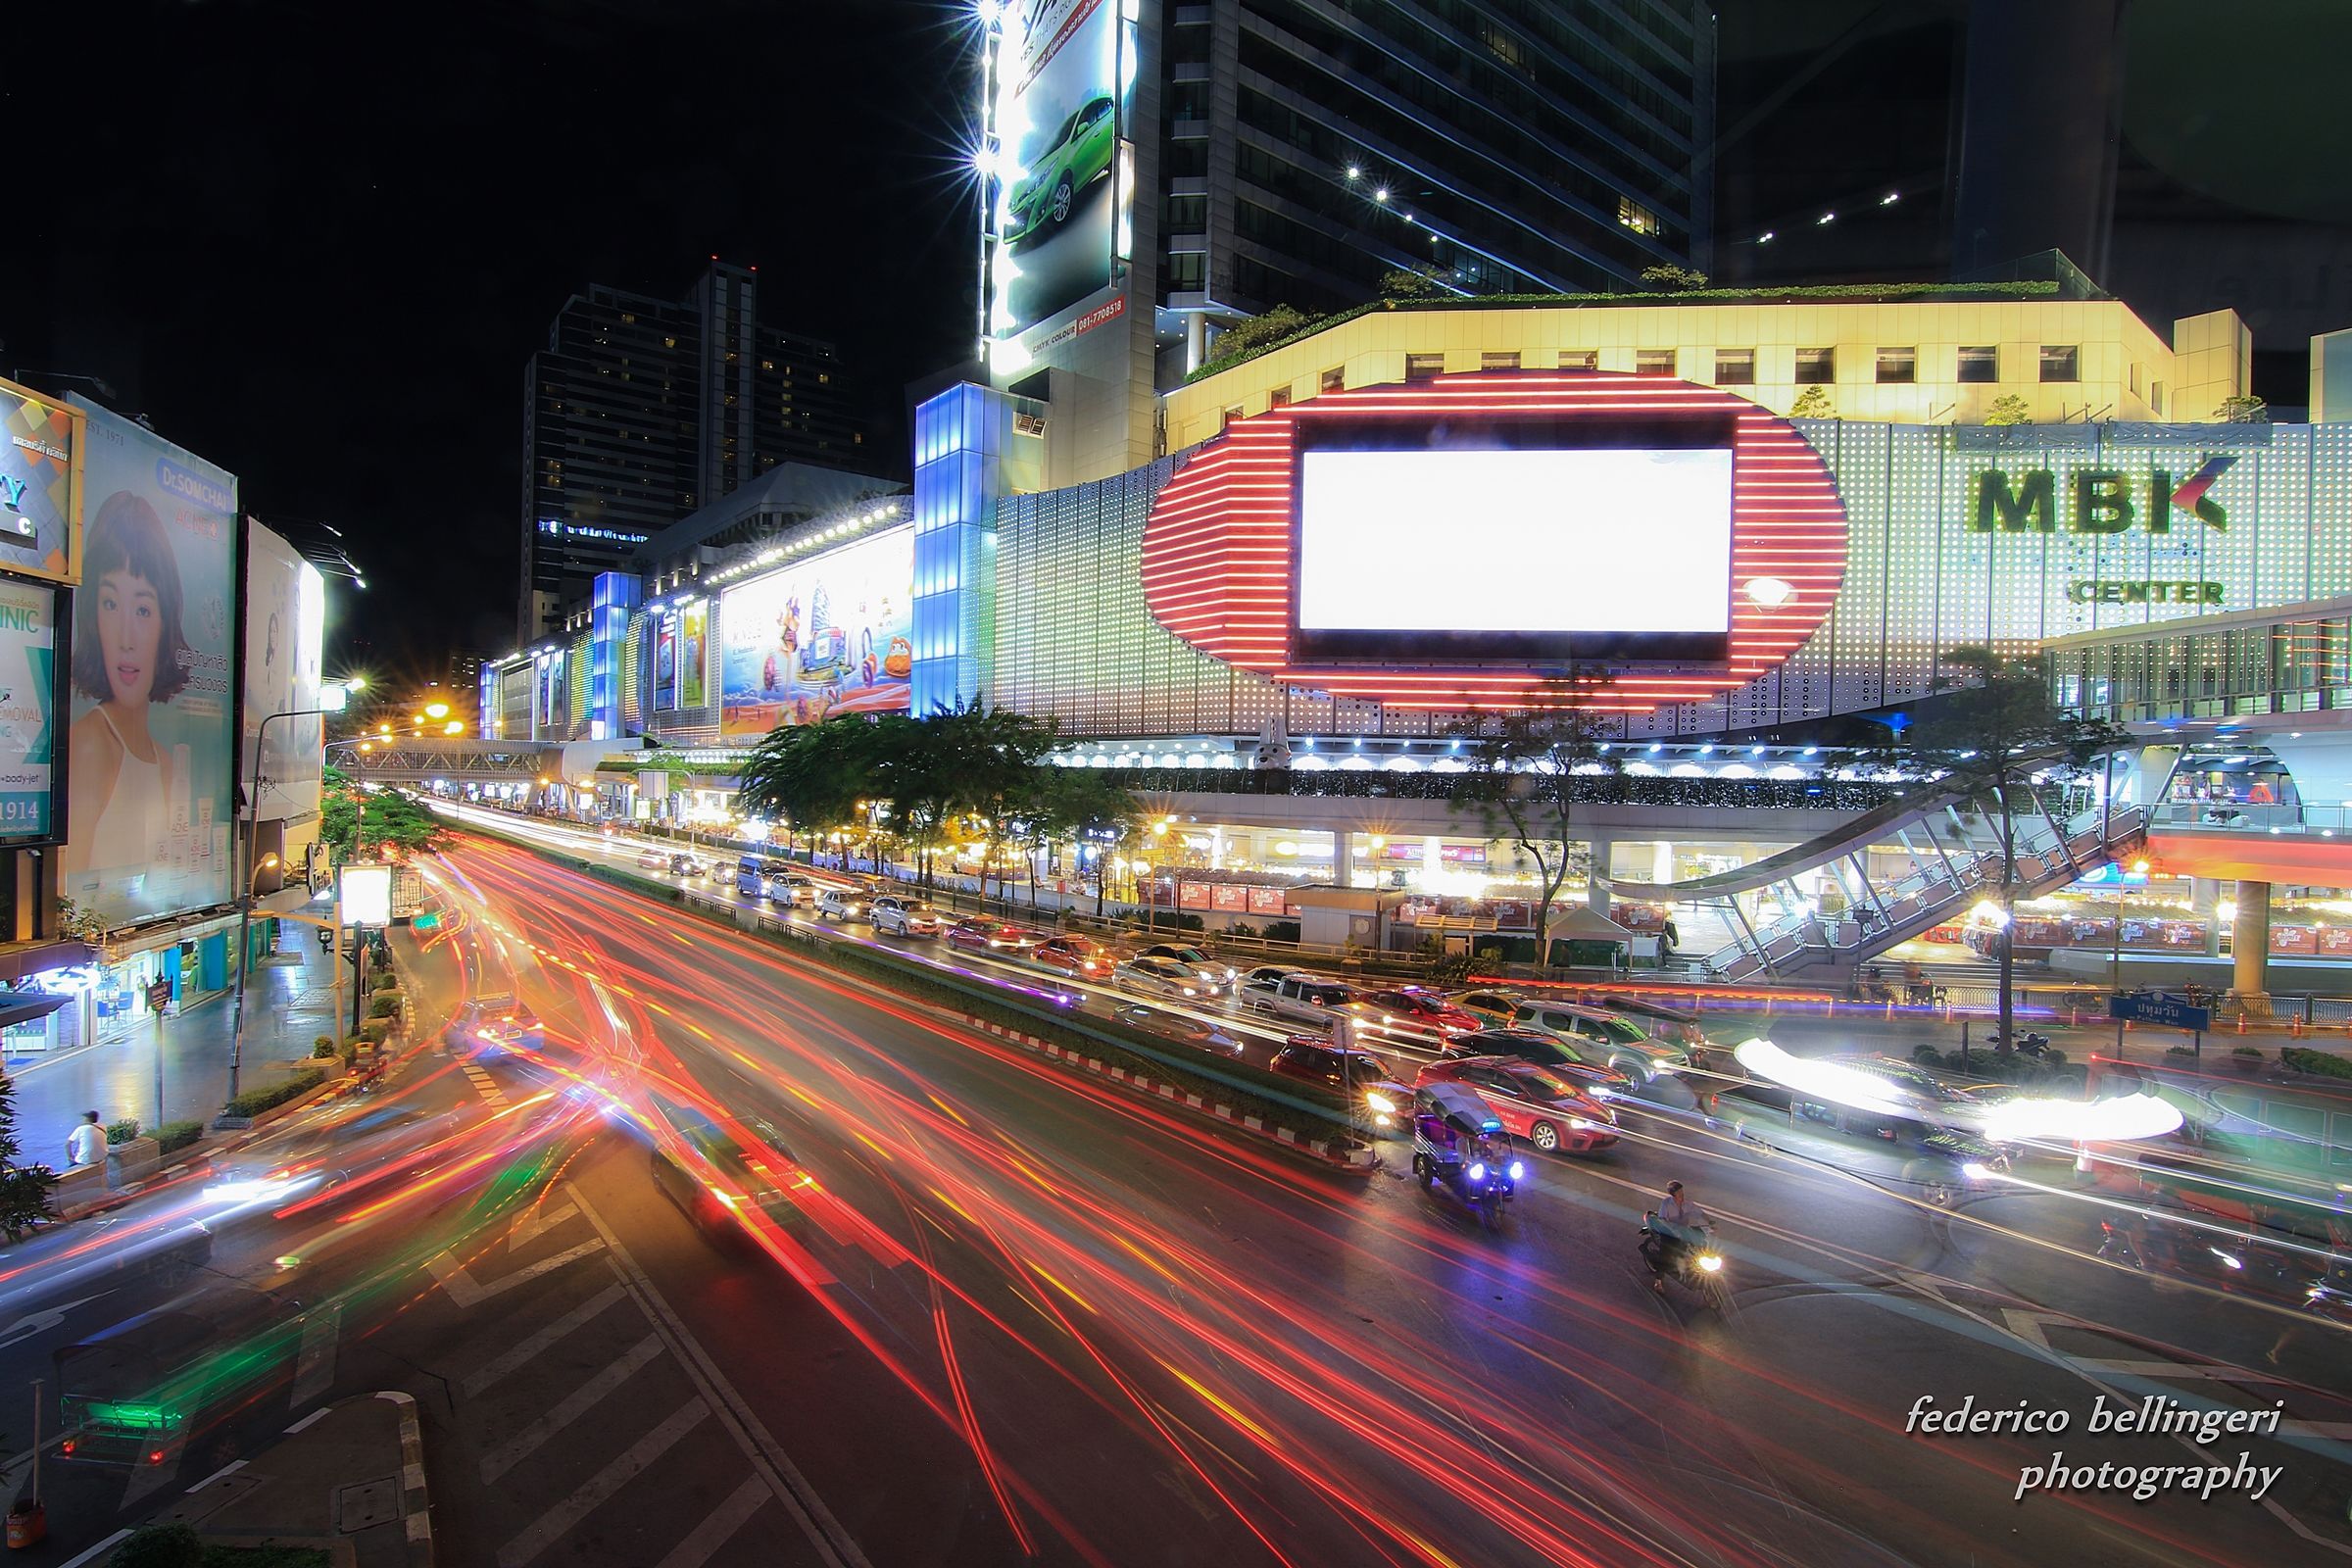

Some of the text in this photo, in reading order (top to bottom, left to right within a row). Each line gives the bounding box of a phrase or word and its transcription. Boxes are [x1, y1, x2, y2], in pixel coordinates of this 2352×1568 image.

[1051, 325, 1075, 344] COLOUR
[106, 430, 124, 446] 1971
[163, 466, 227, 511] Dr.SOMCHAI
[1974, 457, 2241, 534] MBK
[2070, 580, 2225, 605] CENTER
[2137, 1004, 2180, 1018] ปทุมวัน
